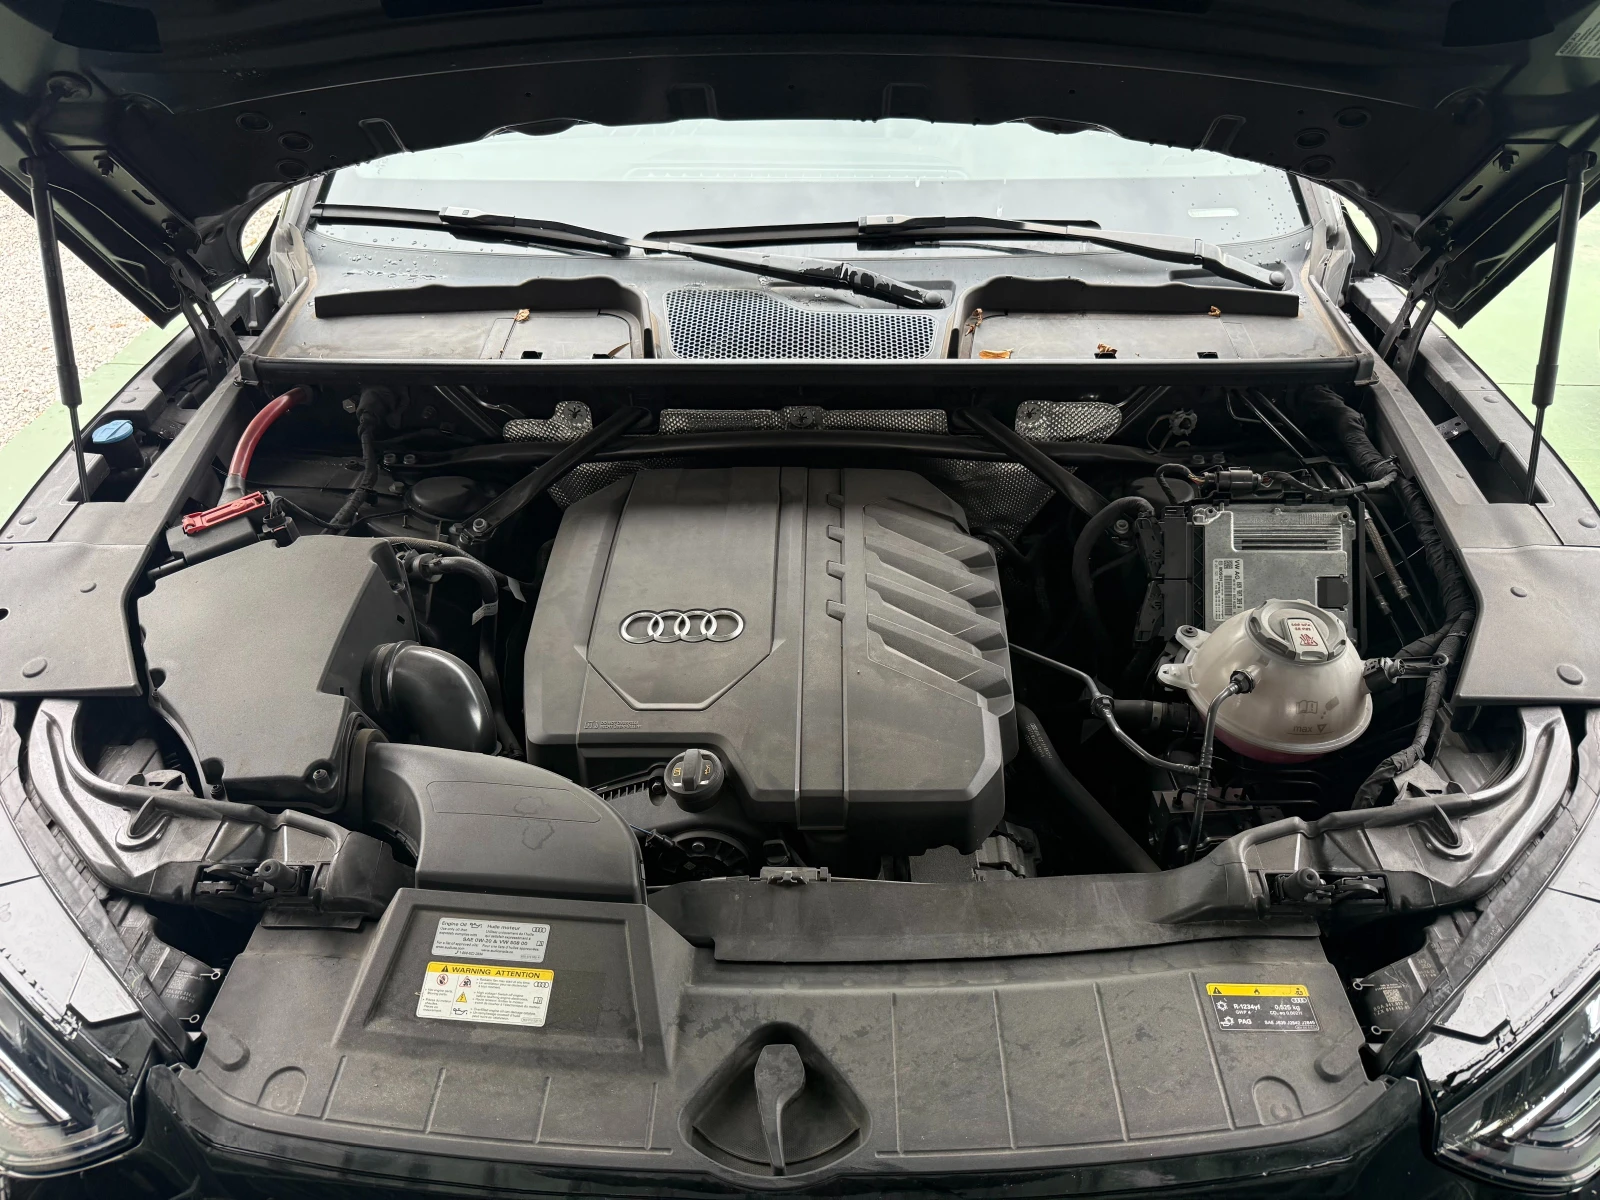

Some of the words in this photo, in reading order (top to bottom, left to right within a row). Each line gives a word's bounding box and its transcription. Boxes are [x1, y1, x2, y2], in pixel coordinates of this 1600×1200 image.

[1235, 560, 1240, 570] VW
[1235, 571, 1240, 580] AG
[452, 967, 491, 975] WARNING
[495, 970, 540, 978] ATTENTION
